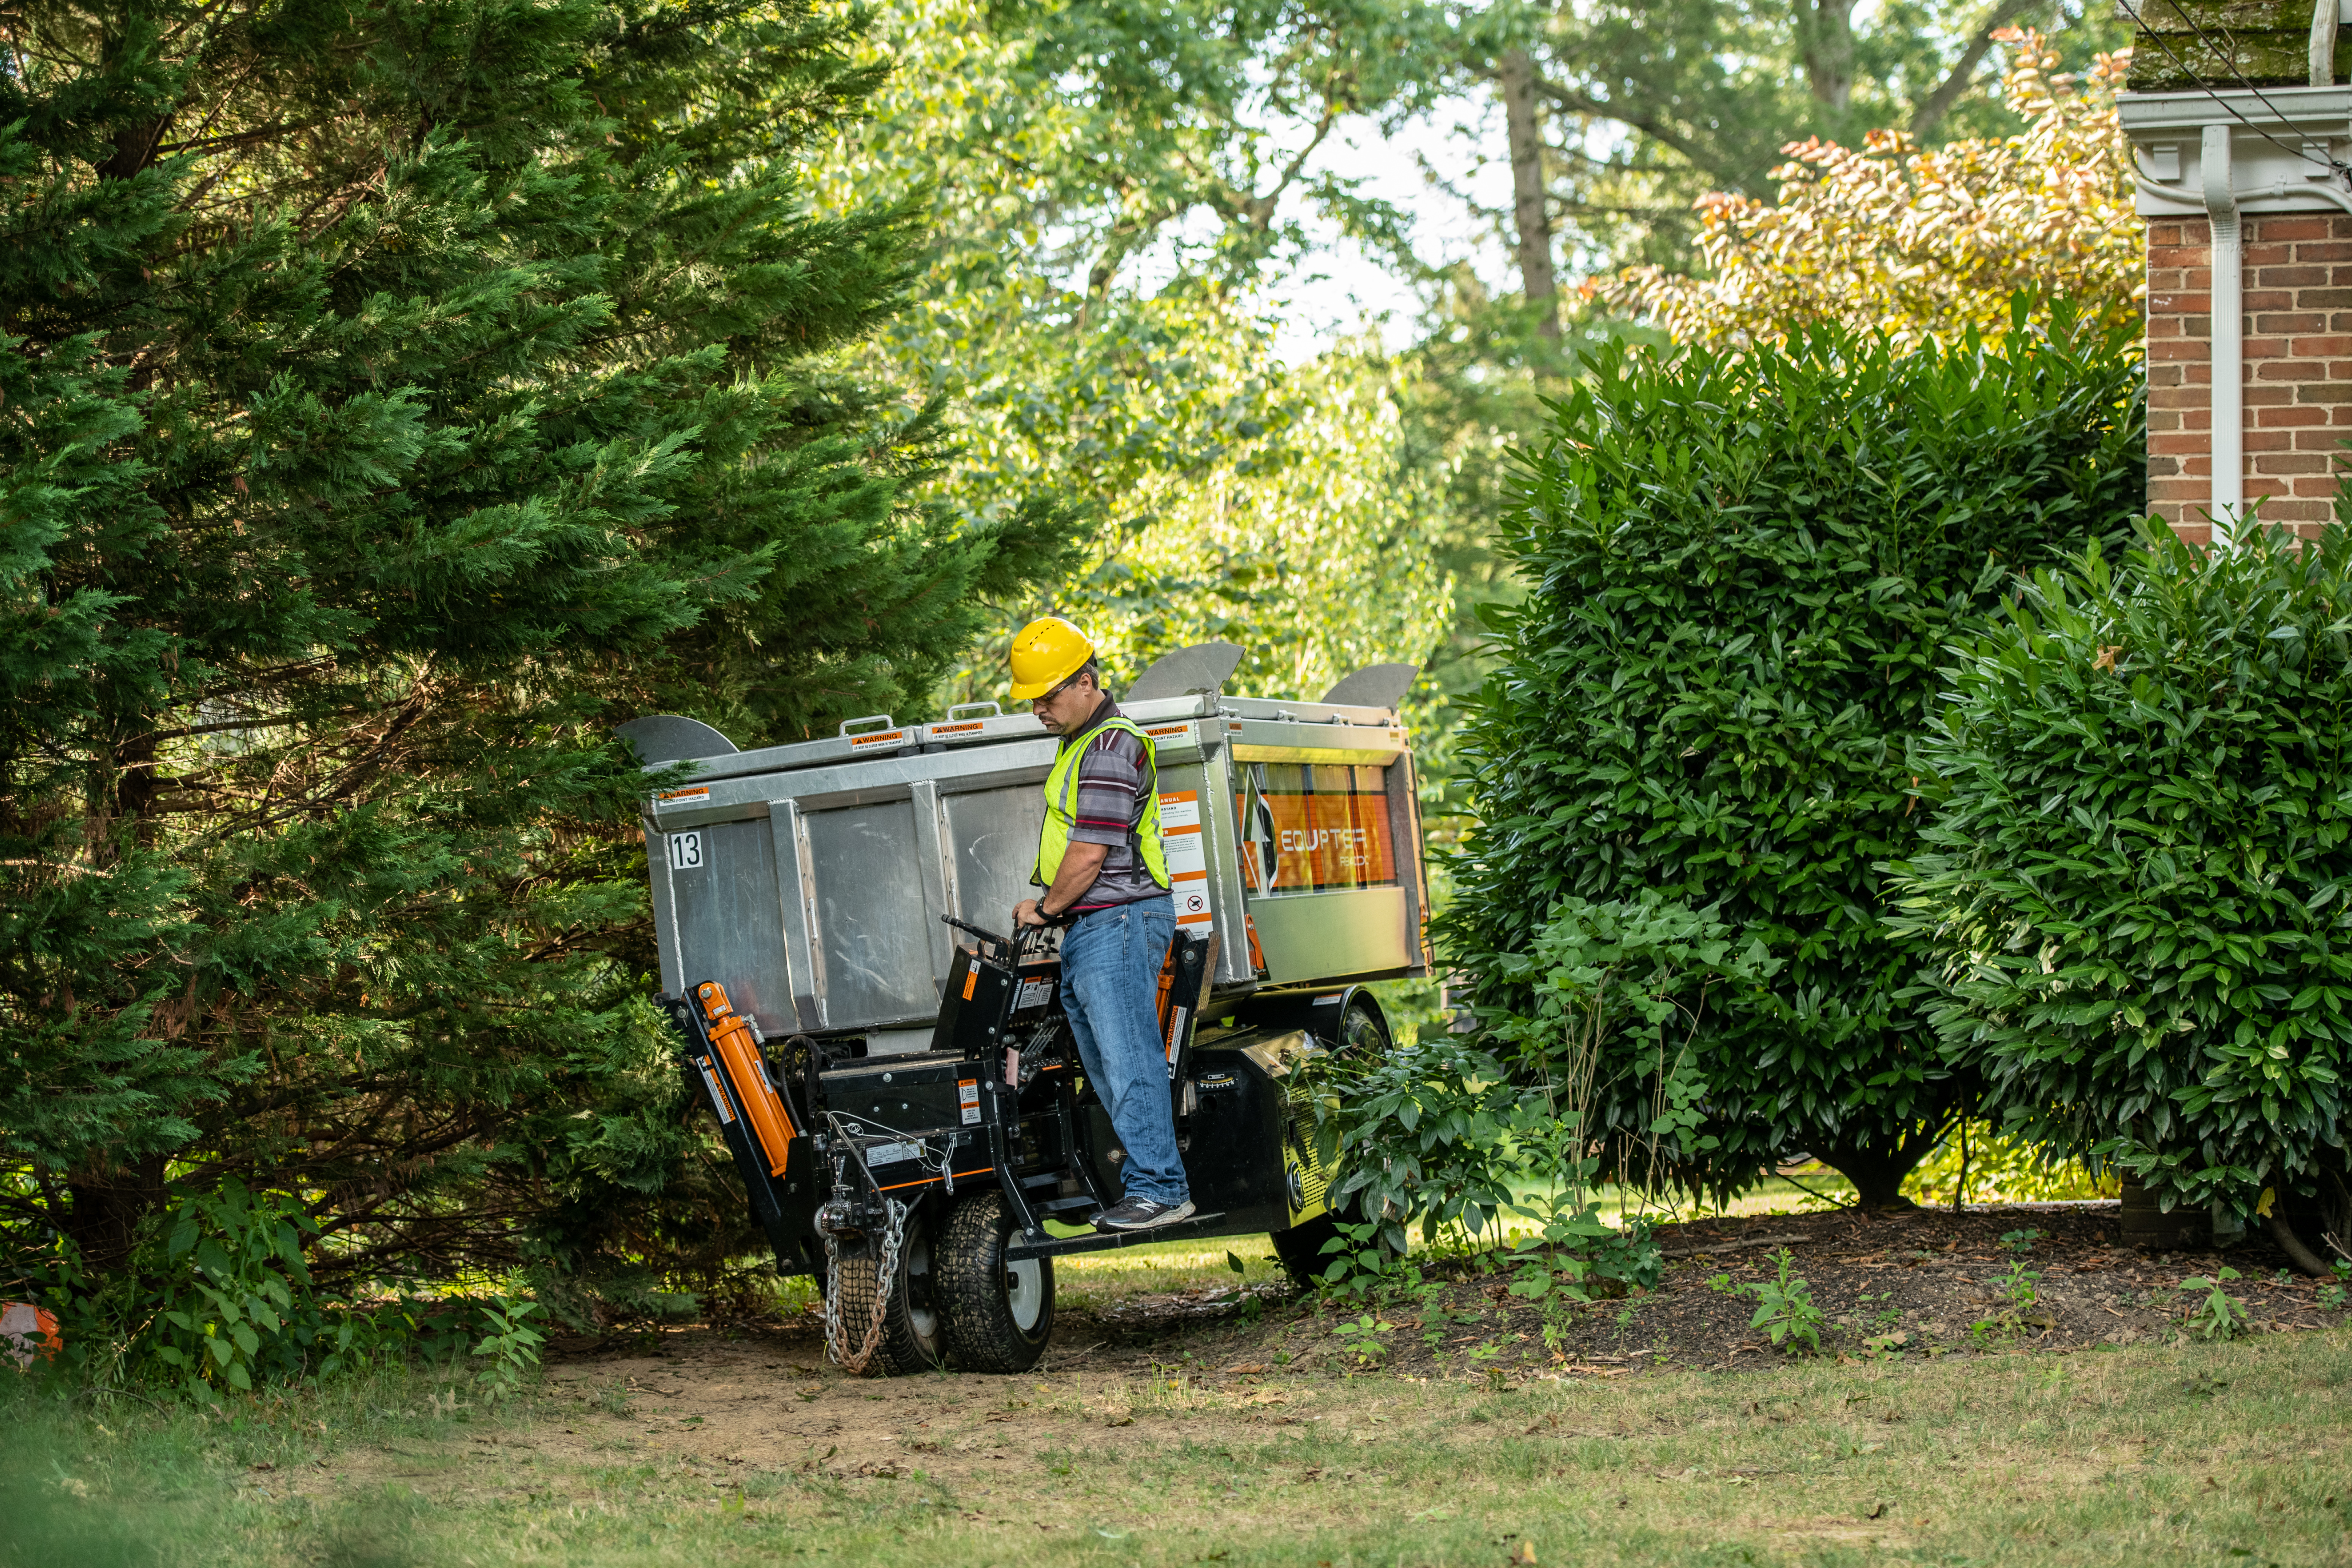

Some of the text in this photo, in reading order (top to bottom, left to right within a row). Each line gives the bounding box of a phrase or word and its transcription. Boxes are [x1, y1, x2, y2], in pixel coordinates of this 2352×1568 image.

[943, 724, 978, 732] WARNING
[1147, 727, 1182, 736] WARNING
[863, 733, 897, 743] WARNING
[670, 789, 704, 798] WARNING
[674, 834, 700, 866] 13
[1168, 1008, 1178, 1041] WARNING
[718, 1087, 734, 1119] WARNING
